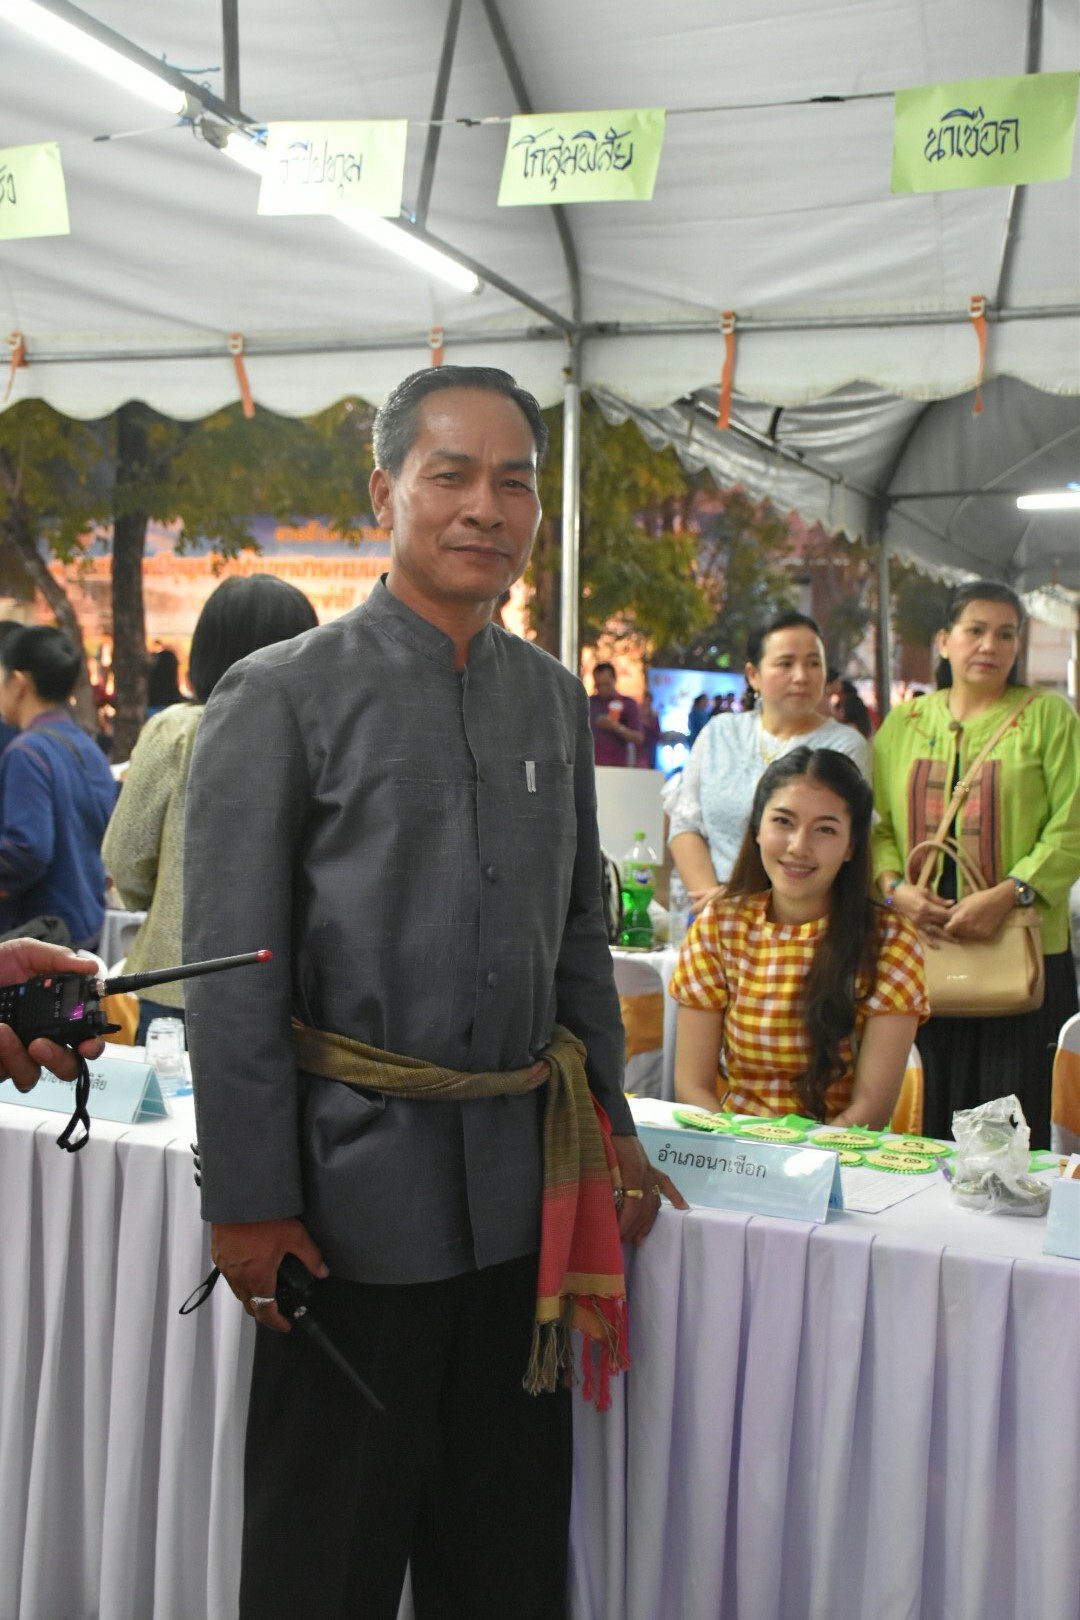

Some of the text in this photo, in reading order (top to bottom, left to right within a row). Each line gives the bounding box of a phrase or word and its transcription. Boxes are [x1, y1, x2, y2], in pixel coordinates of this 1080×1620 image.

[512, 126, 634, 192] โกสุมพิสัย
[924, 106, 1020, 163] นาเชือก
[657, 1143, 767, 1179] อำเภอนาเชือก
